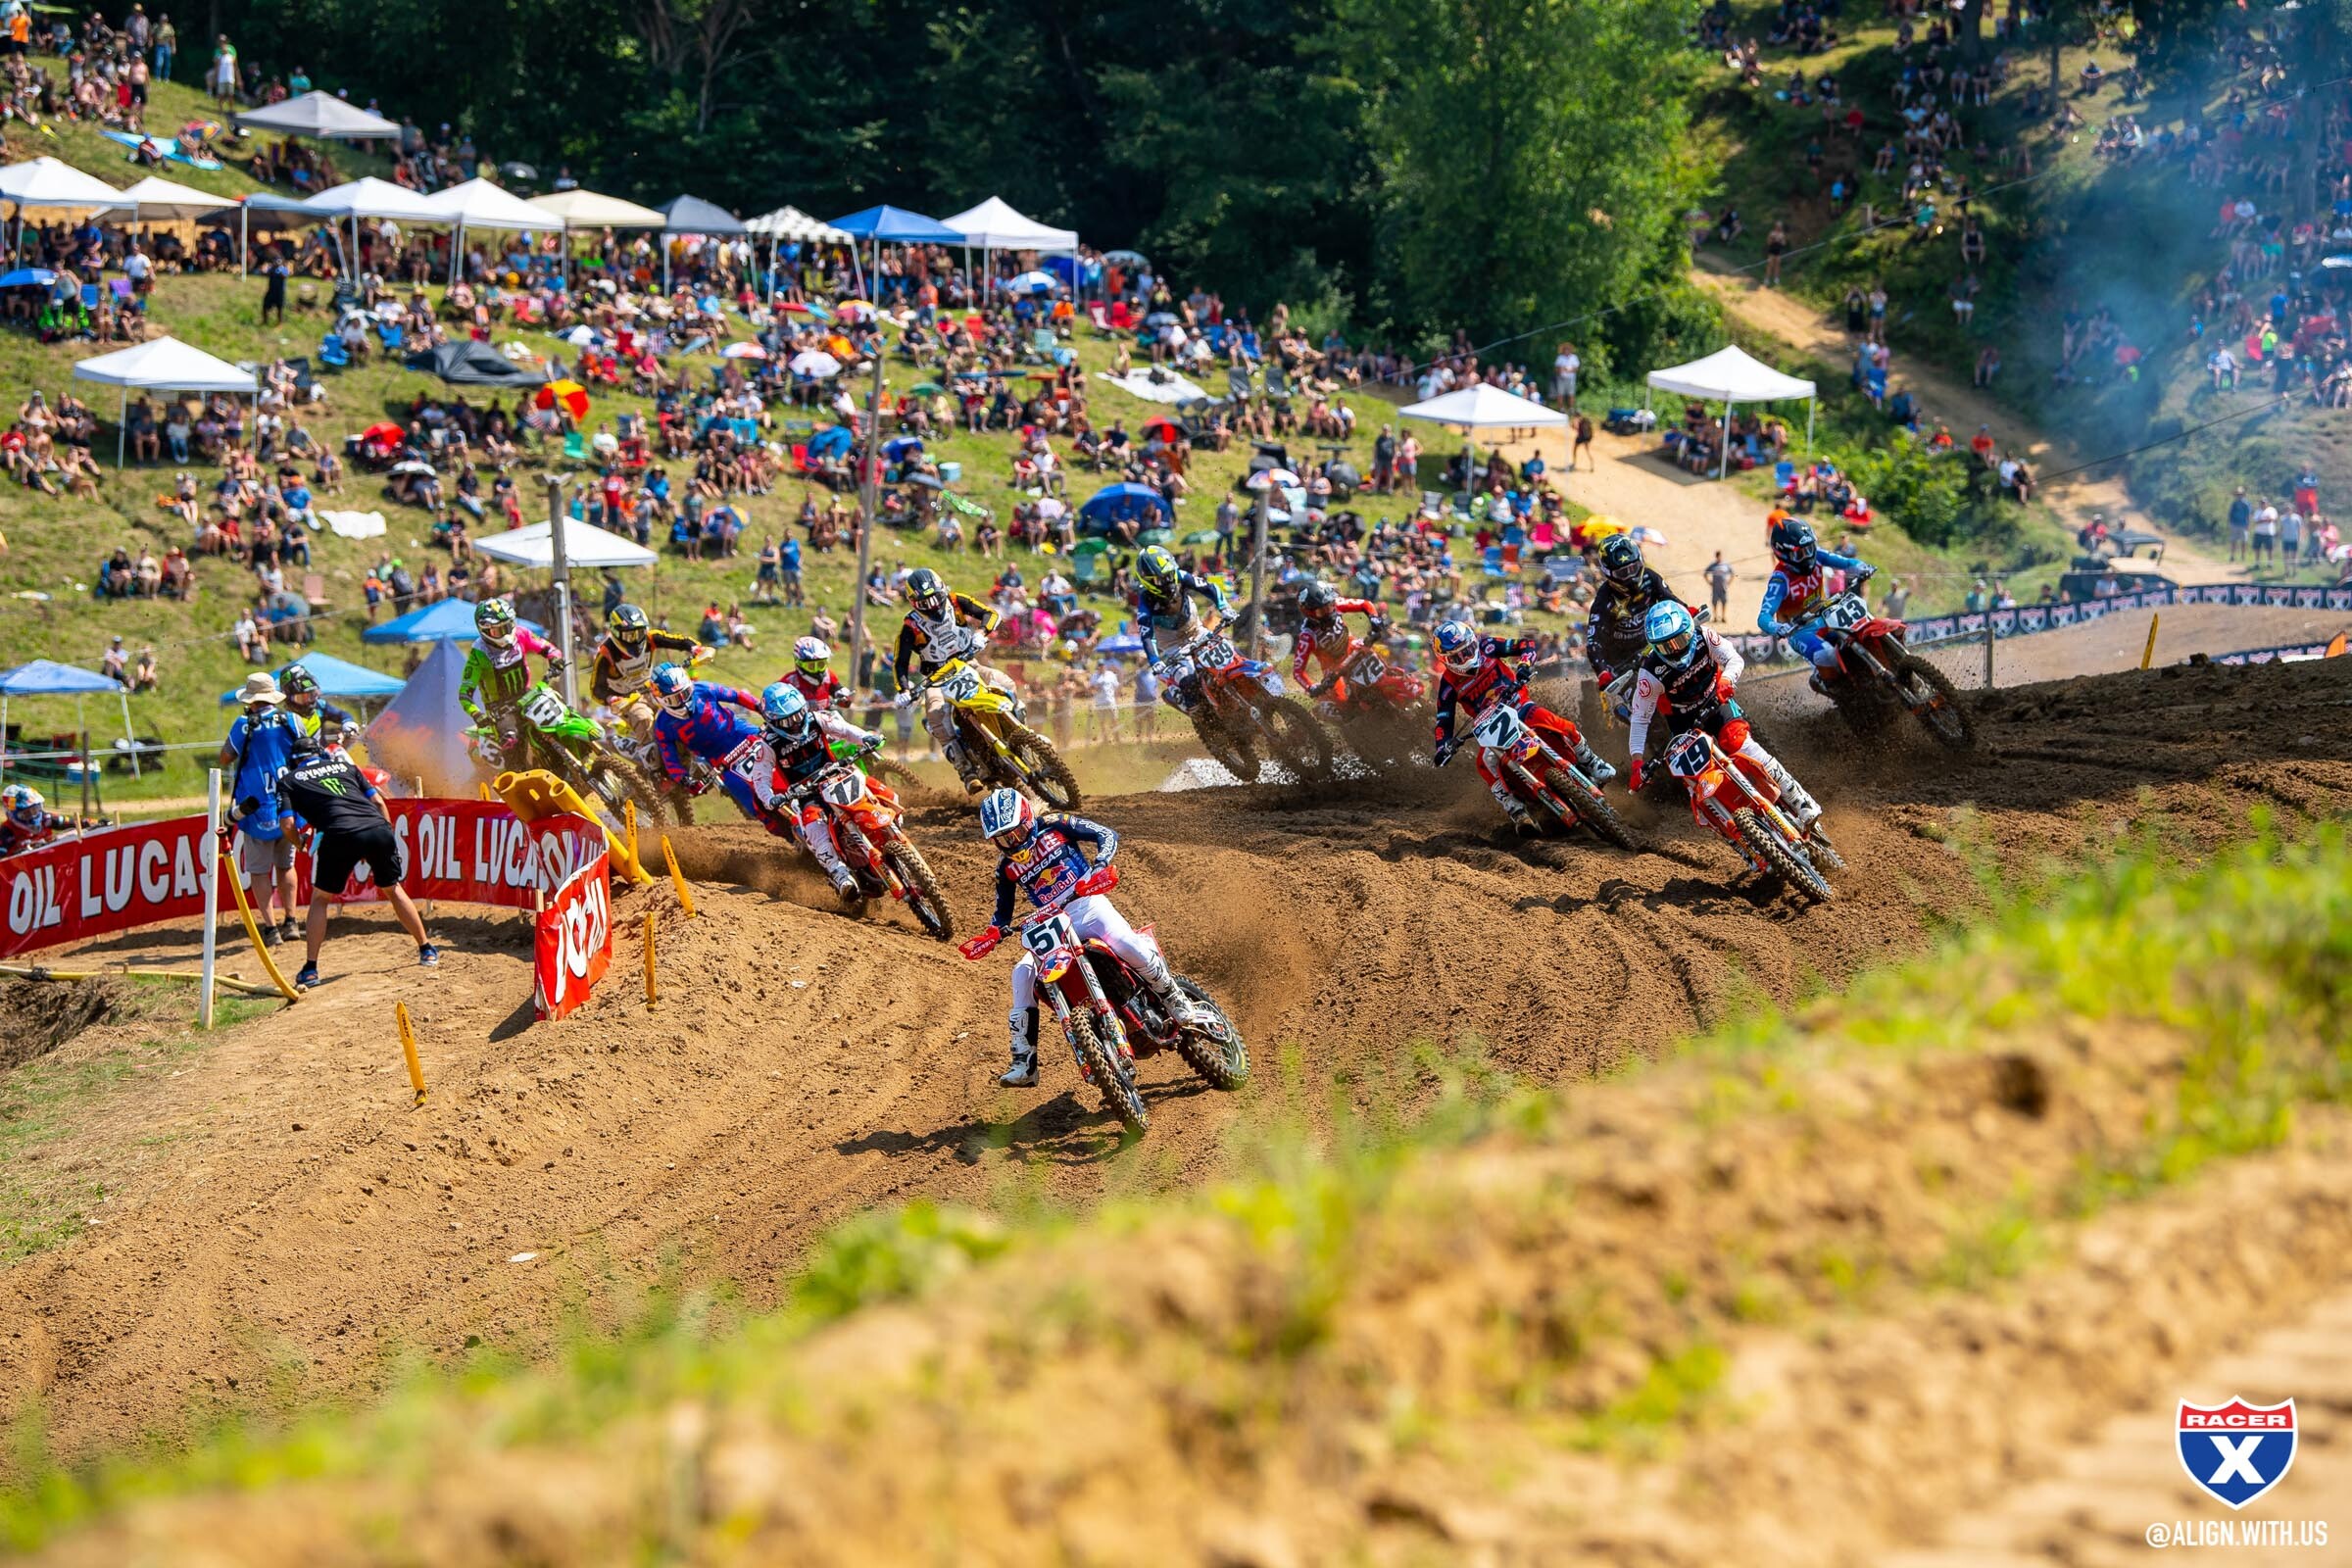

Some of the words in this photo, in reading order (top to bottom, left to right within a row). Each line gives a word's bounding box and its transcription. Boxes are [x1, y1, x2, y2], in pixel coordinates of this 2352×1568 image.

[1836, 599, 1866, 628] 43
[1202, 641, 1235, 668] 139
[1354, 655, 1385, 685] 72
[532, 694, 562, 726] 3
[1489, 711, 1514, 747] 2
[306, 763, 348, 778] YAMAHA
[1675, 736, 1711, 776] 19
[829, 773, 860, 805] 17
[418, 813, 462, 880] OIL
[1020, 847, 1063, 884] GASGAS
[9, 864, 61, 935] OIL
[1039, 883, 1059, 904] Red
[1056, 869, 1078, 892] Bull
[1085, 880, 1113, 895] ACERBIS
[1027, 916, 1065, 956] 51
